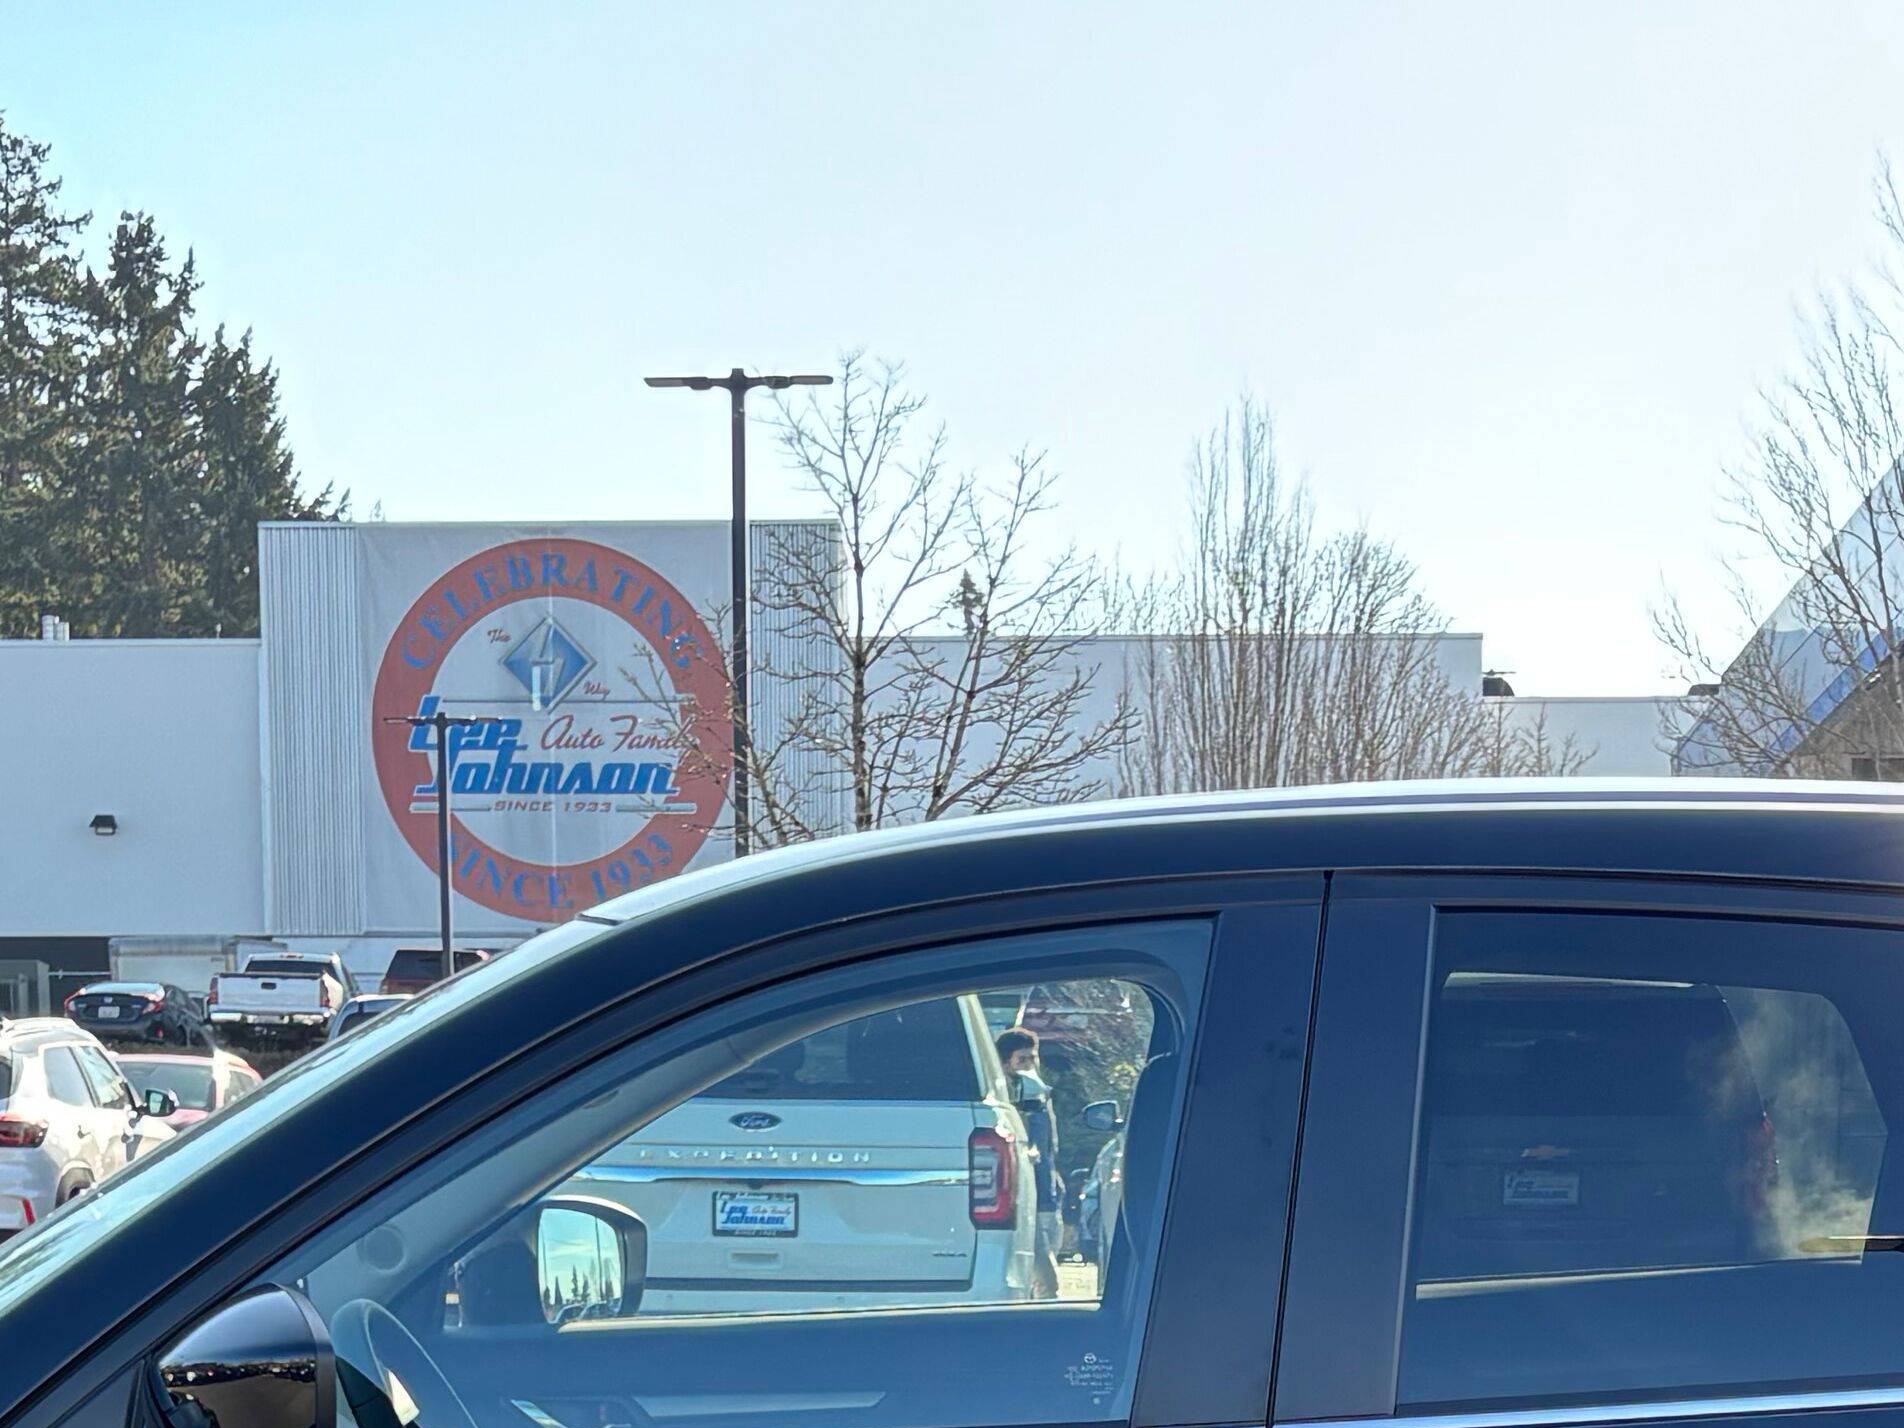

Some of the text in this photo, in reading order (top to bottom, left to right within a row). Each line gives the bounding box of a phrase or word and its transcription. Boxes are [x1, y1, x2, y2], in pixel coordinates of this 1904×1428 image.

[401, 551, 703, 671] CELEBRATING
[408, 694, 529, 751] Lee
[540, 714, 605, 750] Auto
[413, 749, 680, 796] Johnson
[495, 800, 612, 813] SINCE 1933
[592, 833, 673, 900] 1933
